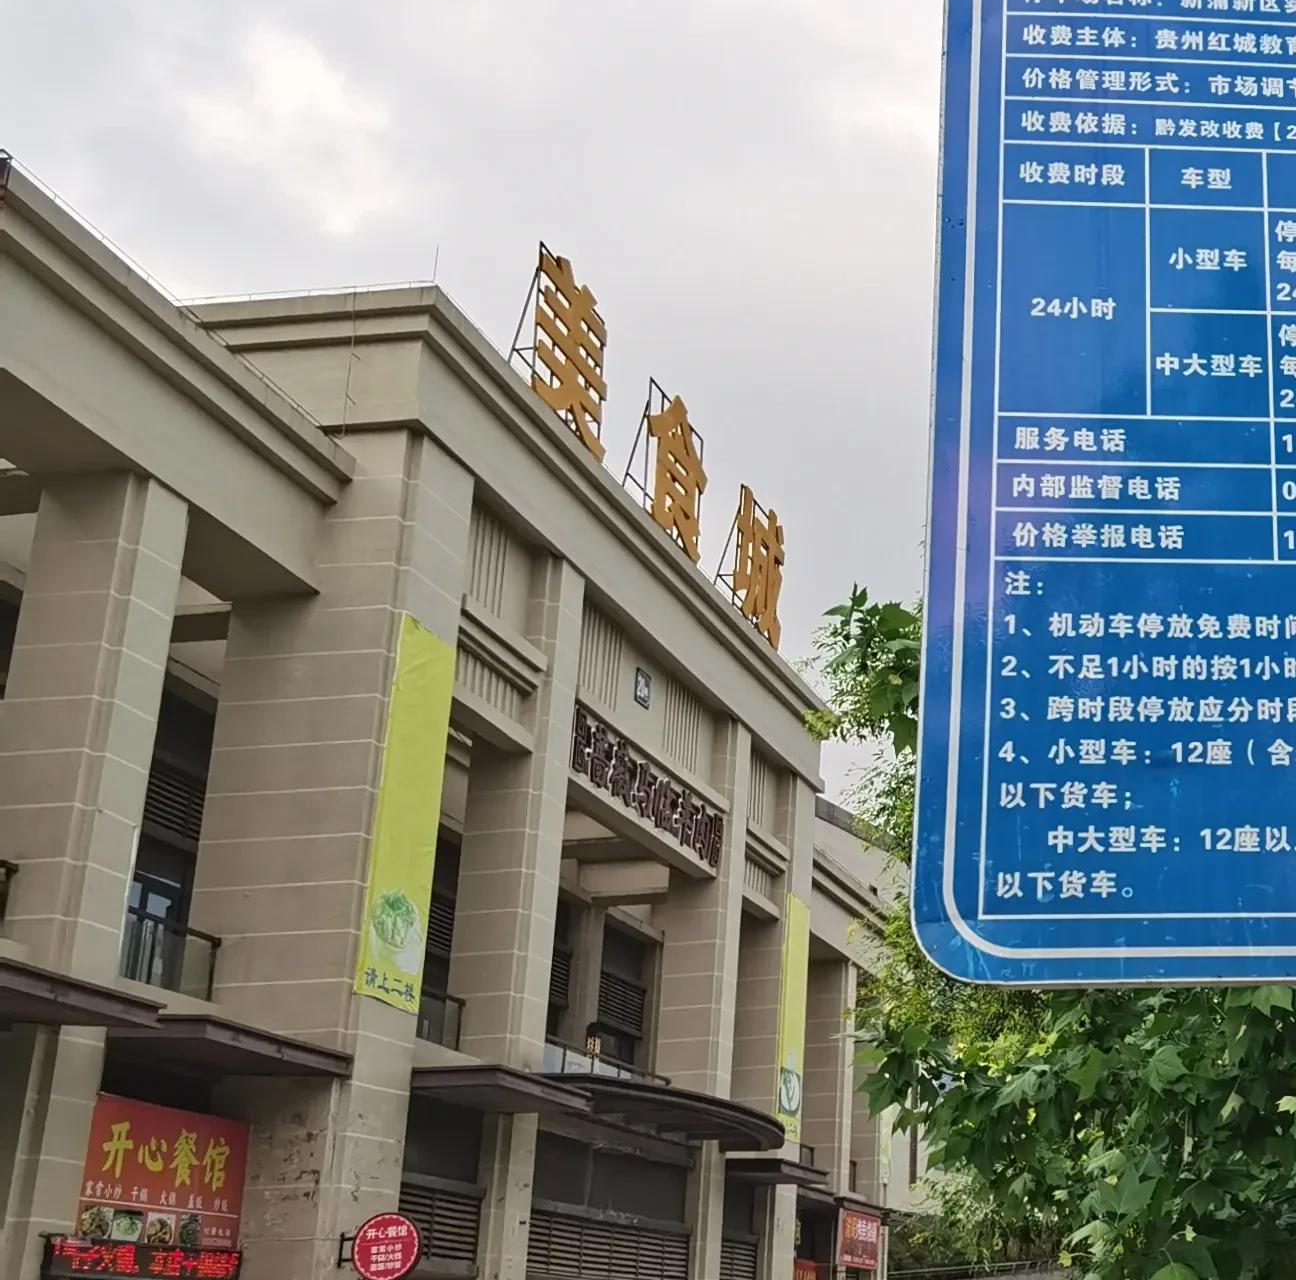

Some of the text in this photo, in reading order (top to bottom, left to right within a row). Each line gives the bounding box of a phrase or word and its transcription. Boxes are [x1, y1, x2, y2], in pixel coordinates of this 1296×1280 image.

[1020, 162, 1124, 185] 收费时段
[1181, 168, 1231, 189] 车型
[1169, 248, 1246, 271] 小型车
[1031, 297, 1116, 320] 24小时
[1156, 353, 1262, 377] 中大型车
[1015, 427, 1126, 452] 服务电话
[531, 254, 785, 650] 美食城
[1013, 473, 1180, 500] 内部监督电话
[1013, 522, 1183, 549] 价格举报电话
[1005, 571, 1045, 595] 注：
[101, 1121, 231, 1192] 开心餐馆
[366, 1224, 408, 1240] 开心餐馆
